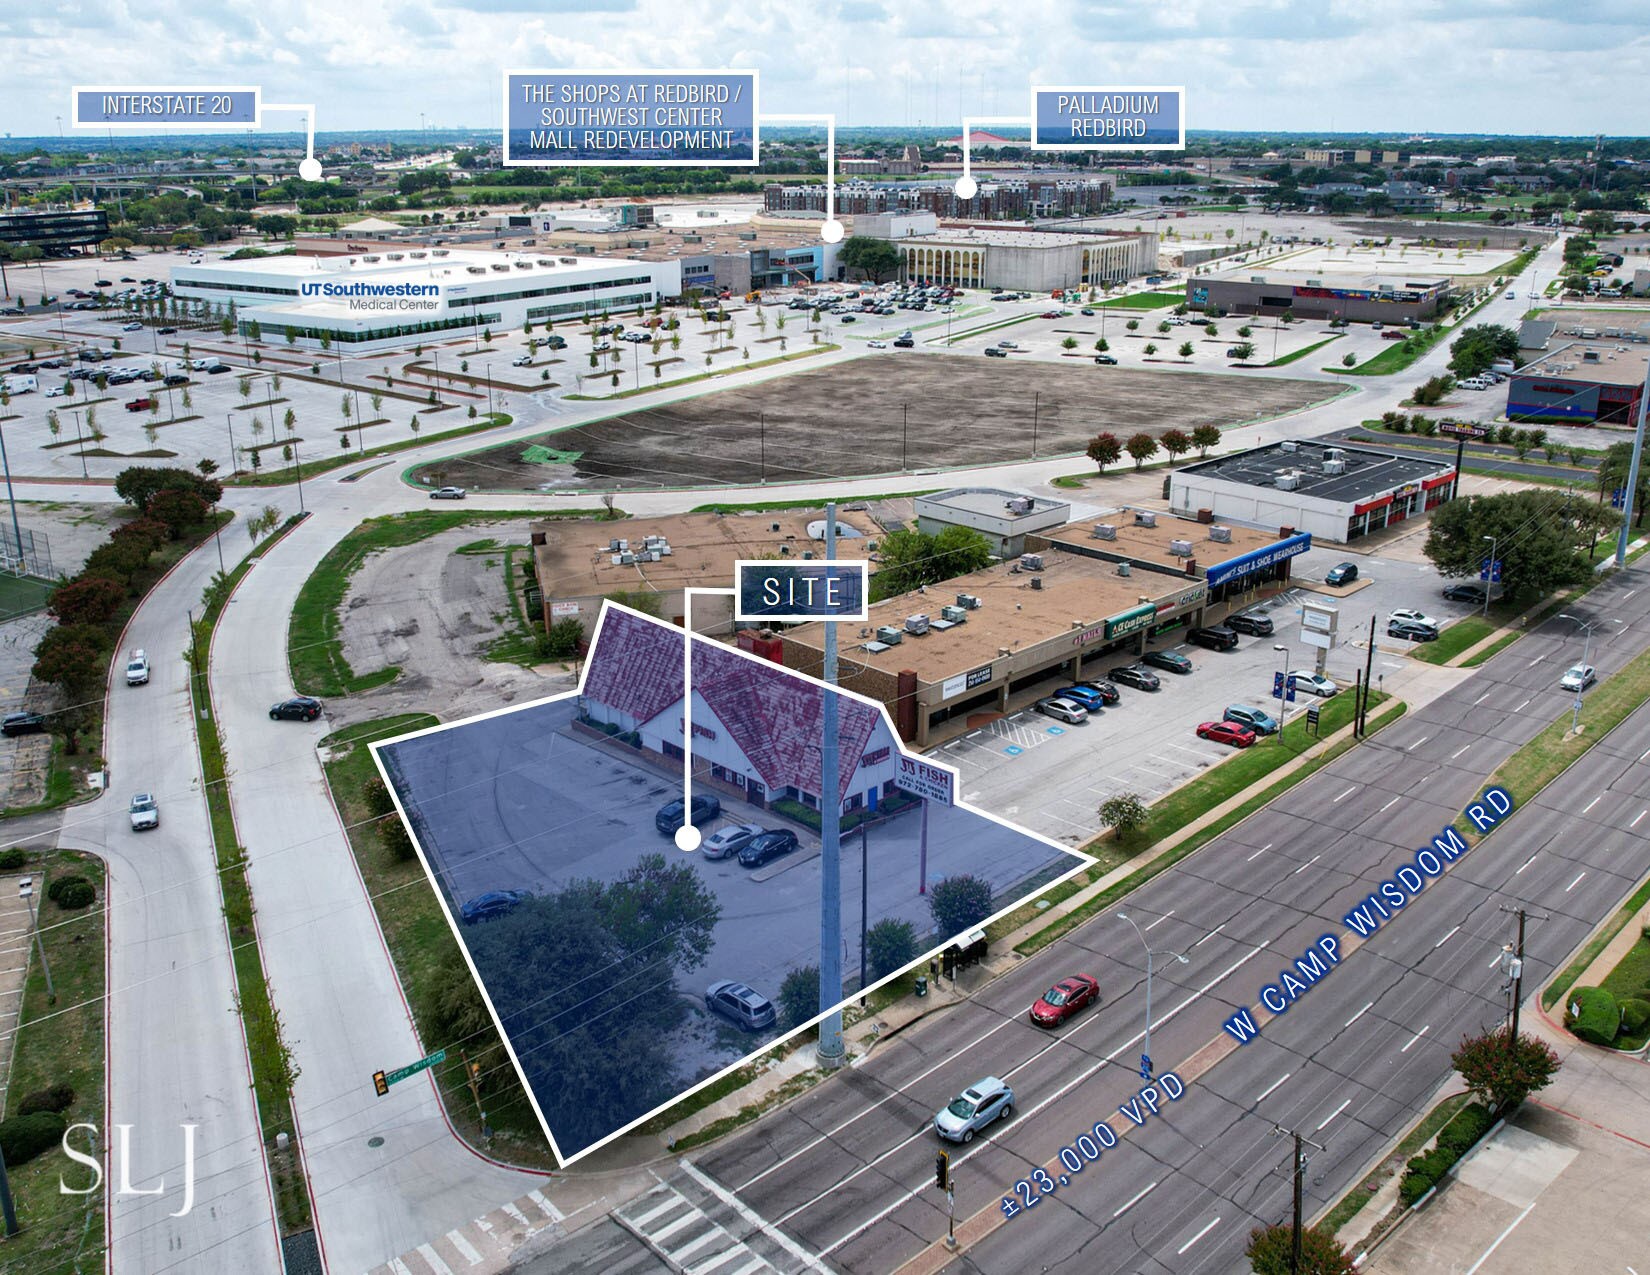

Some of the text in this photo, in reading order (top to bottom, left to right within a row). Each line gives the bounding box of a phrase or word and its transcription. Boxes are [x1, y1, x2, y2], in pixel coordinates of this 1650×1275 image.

[1237, 562, 1250, 575] SUIT
[1250, 560, 1256, 570] &
[1256, 554, 1272, 568] SHOE
[918, 764, 948, 785] FISH
[413, 1053, 443, 1069] Wisdom
